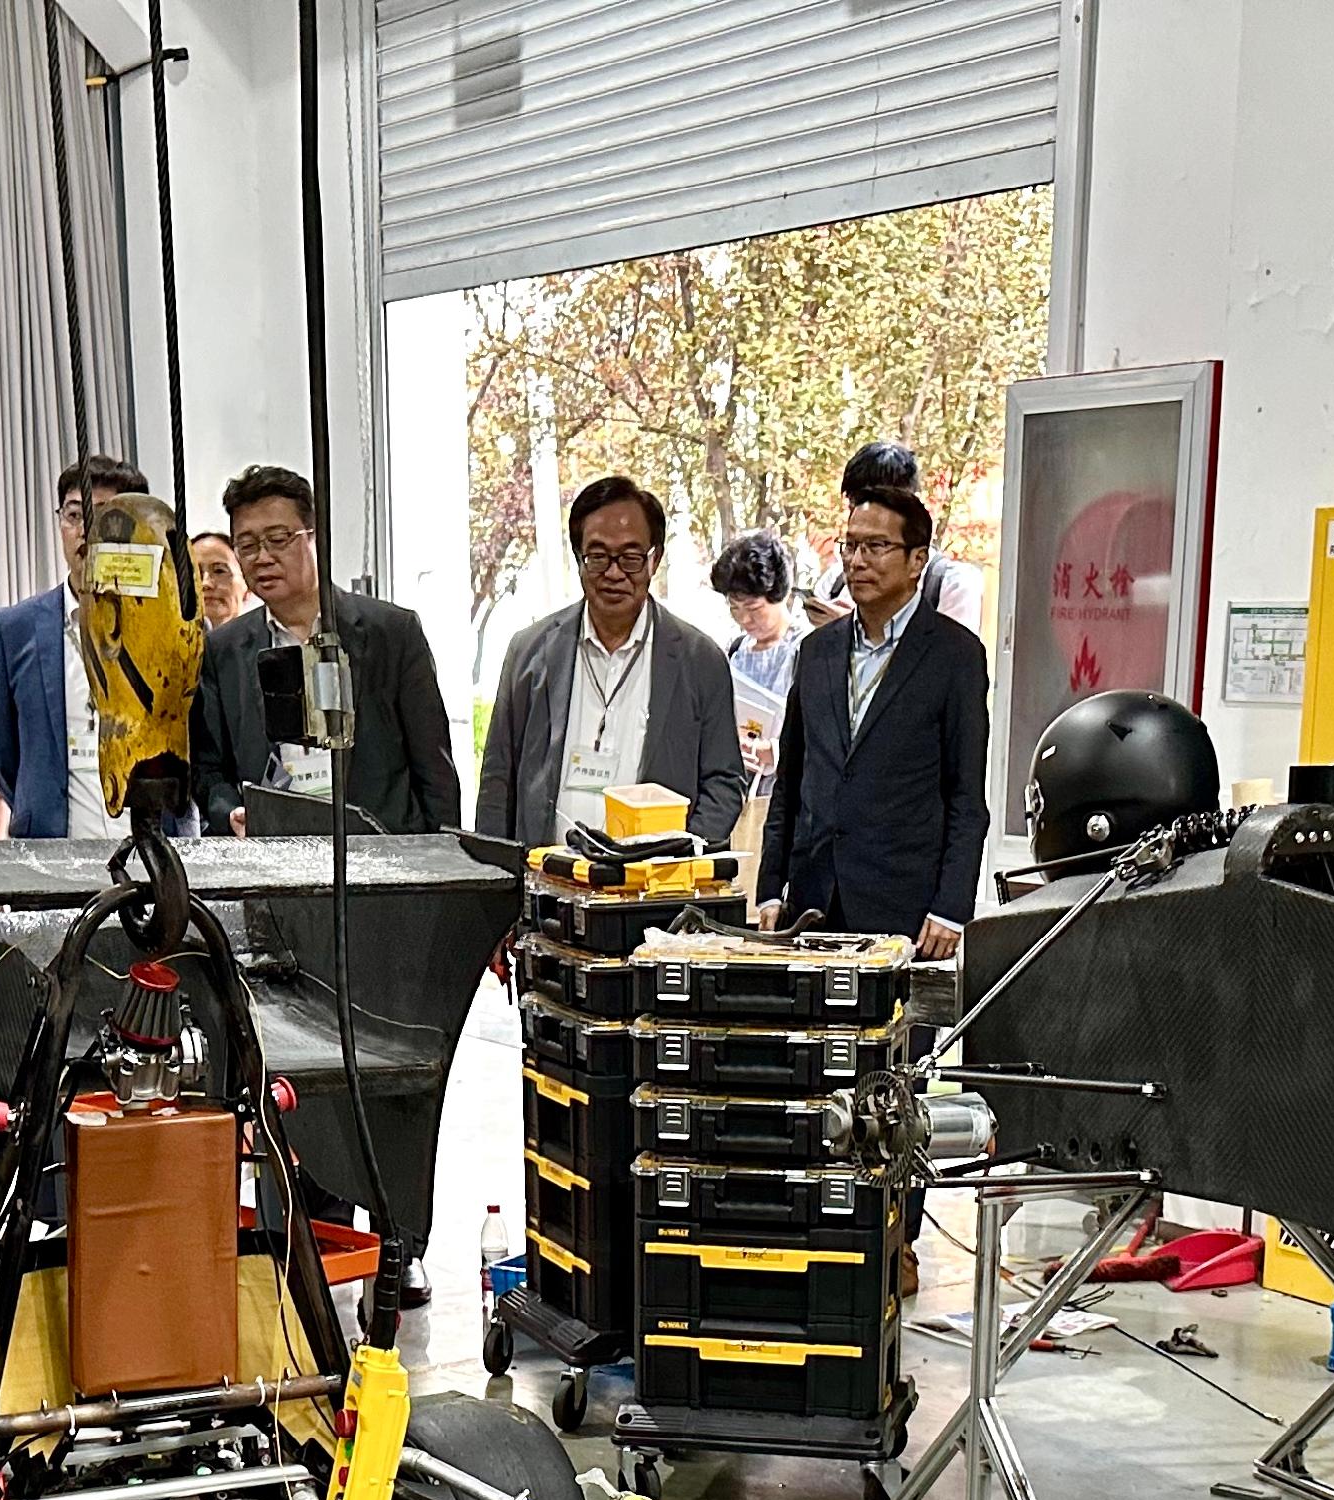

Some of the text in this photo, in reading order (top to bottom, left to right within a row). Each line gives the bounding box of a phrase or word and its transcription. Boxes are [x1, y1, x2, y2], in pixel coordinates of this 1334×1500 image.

[1053, 562, 1135, 600] 消火栓
[1051, 606, 1131, 621] FIRE HYDRANT
